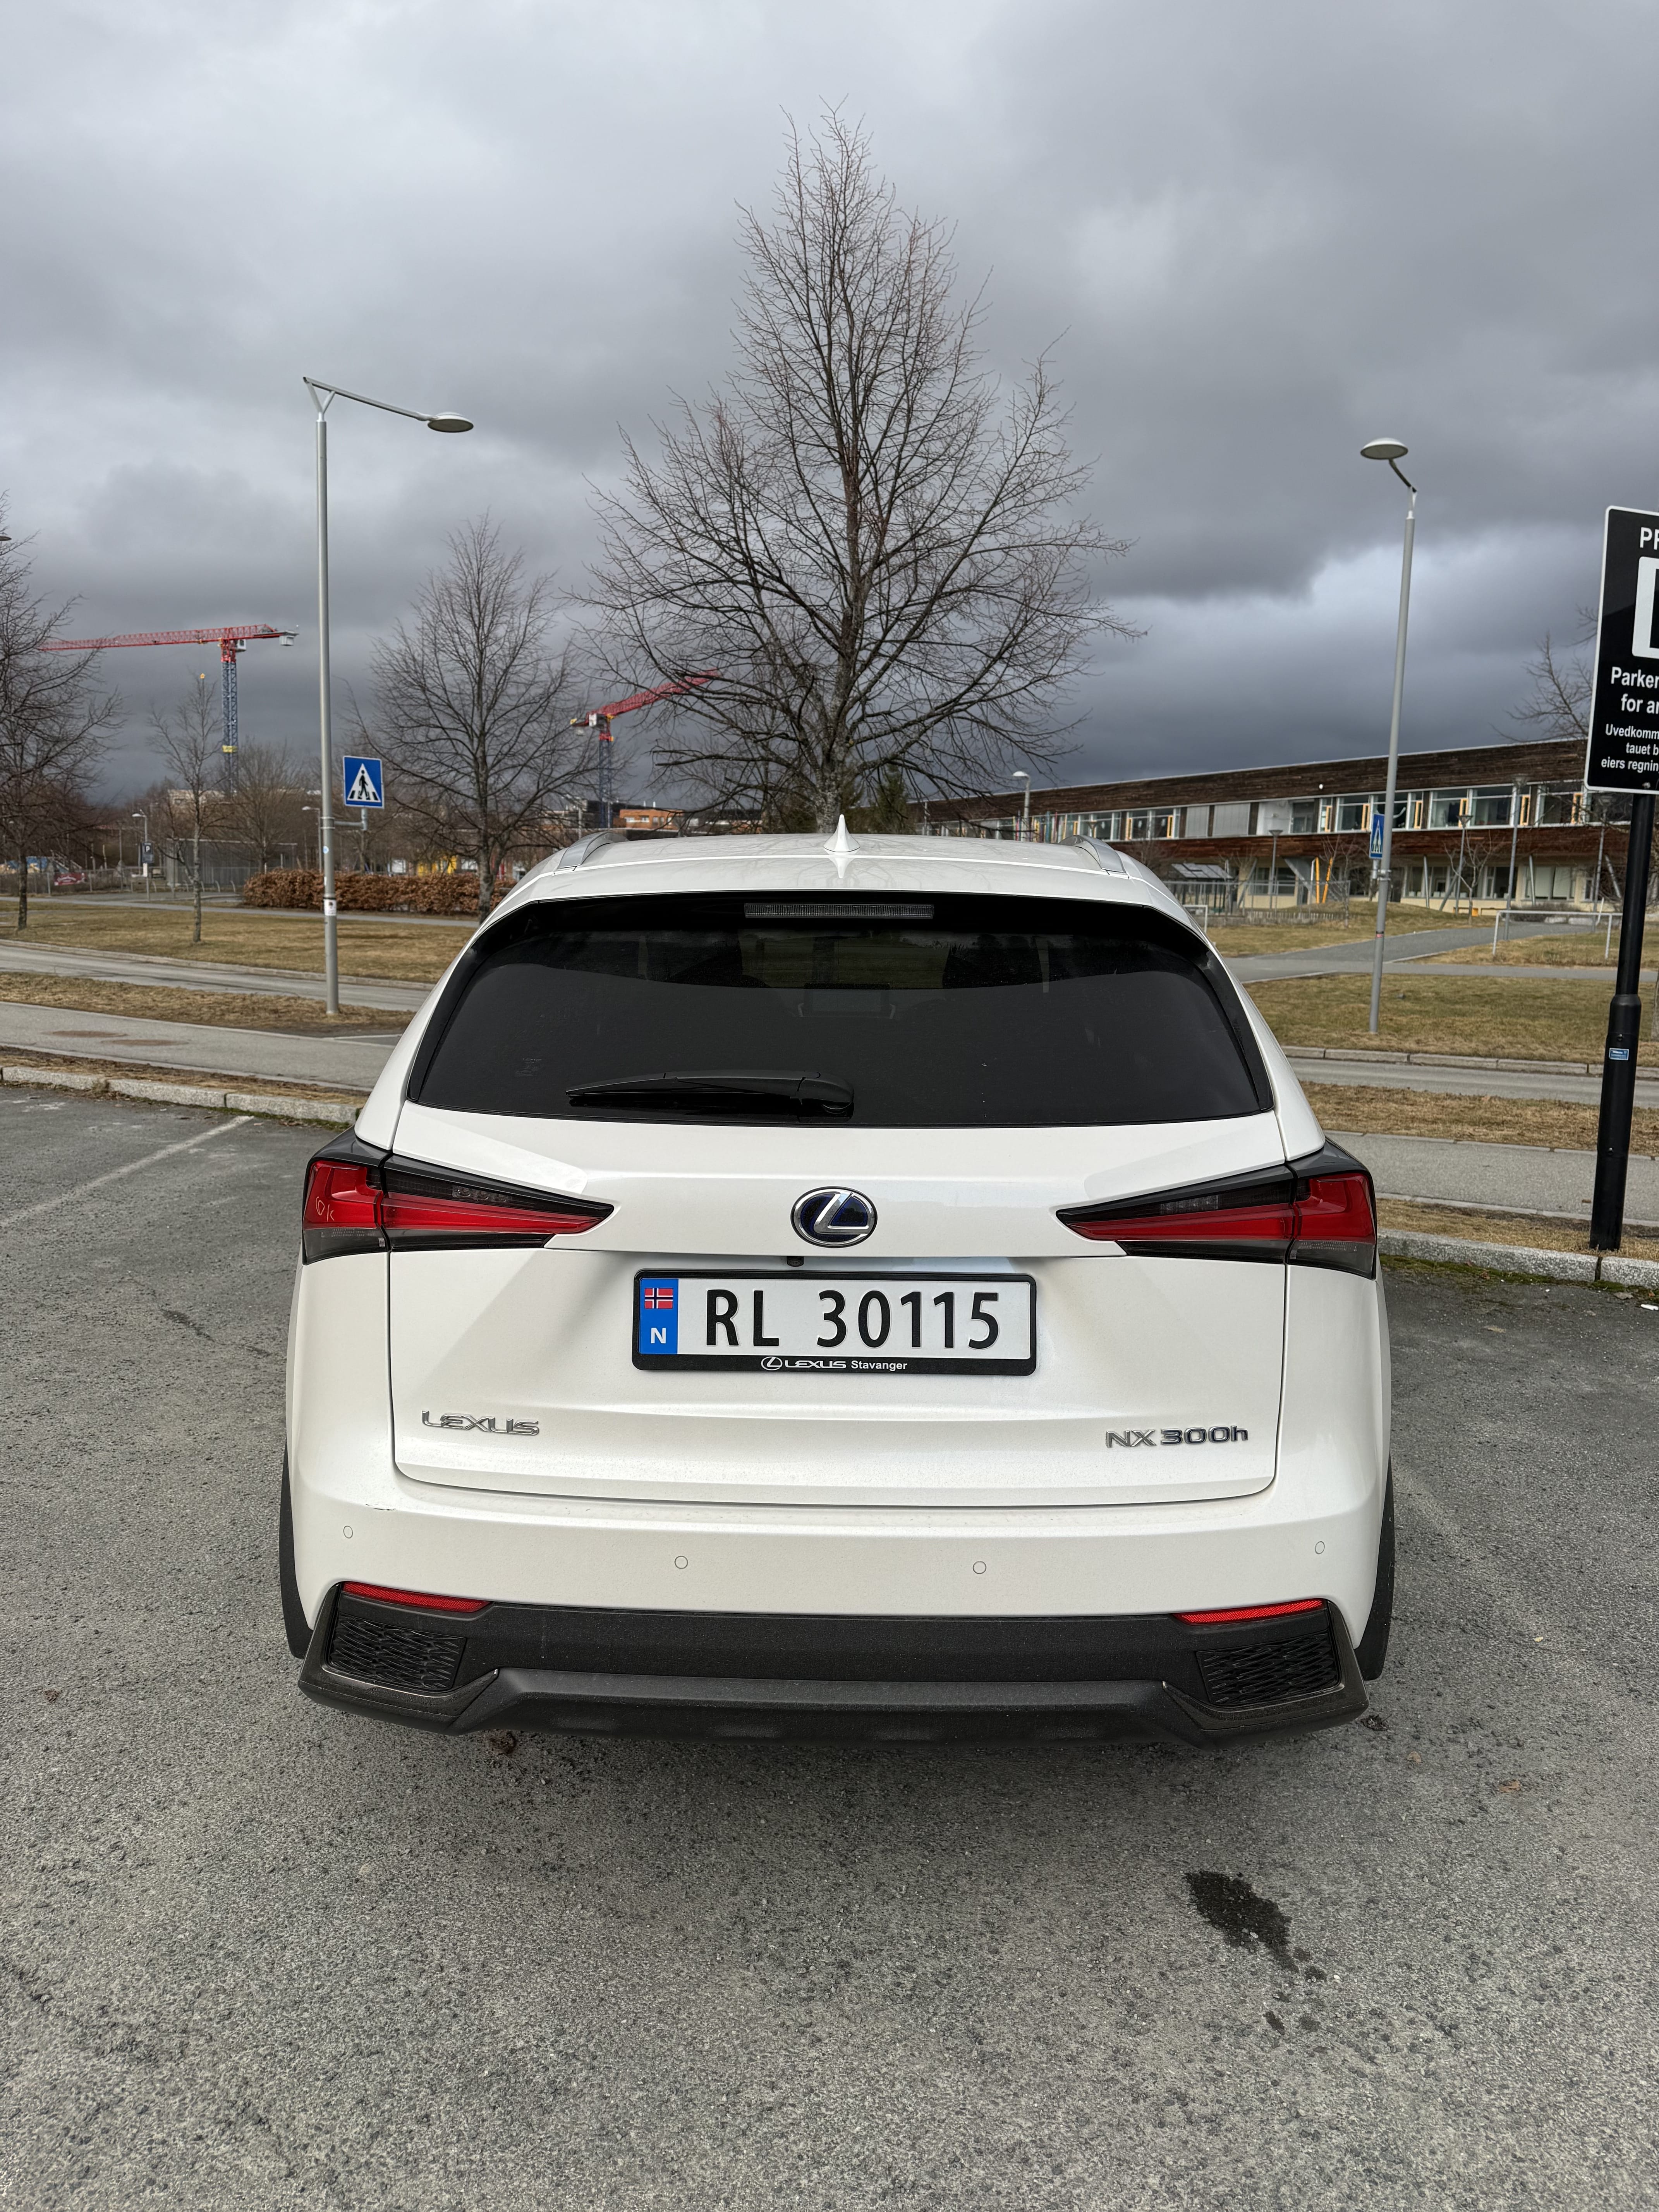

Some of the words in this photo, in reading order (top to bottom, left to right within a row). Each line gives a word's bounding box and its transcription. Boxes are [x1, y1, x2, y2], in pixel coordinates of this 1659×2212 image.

[1621, 693, 1643, 712] for
[1605, 723, 1659, 740] Uvedkomm
[1626, 742, 1650, 755] tauet
[1601, 756, 1625, 769] eiers
[1628, 760, 1659, 773] regnin
[706, 1289, 779, 1347] RL
[817, 1290, 999, 1349] 30115
[651, 1328, 666, 1344] N
[785, 1360, 847, 1369] LEXUS
[851, 1360, 908, 1371] Stavanger
[422, 1410, 539, 1436] LEXUS
[1106, 1429, 1157, 1448] NX
[1160, 1425, 1249, 1445] 300h
